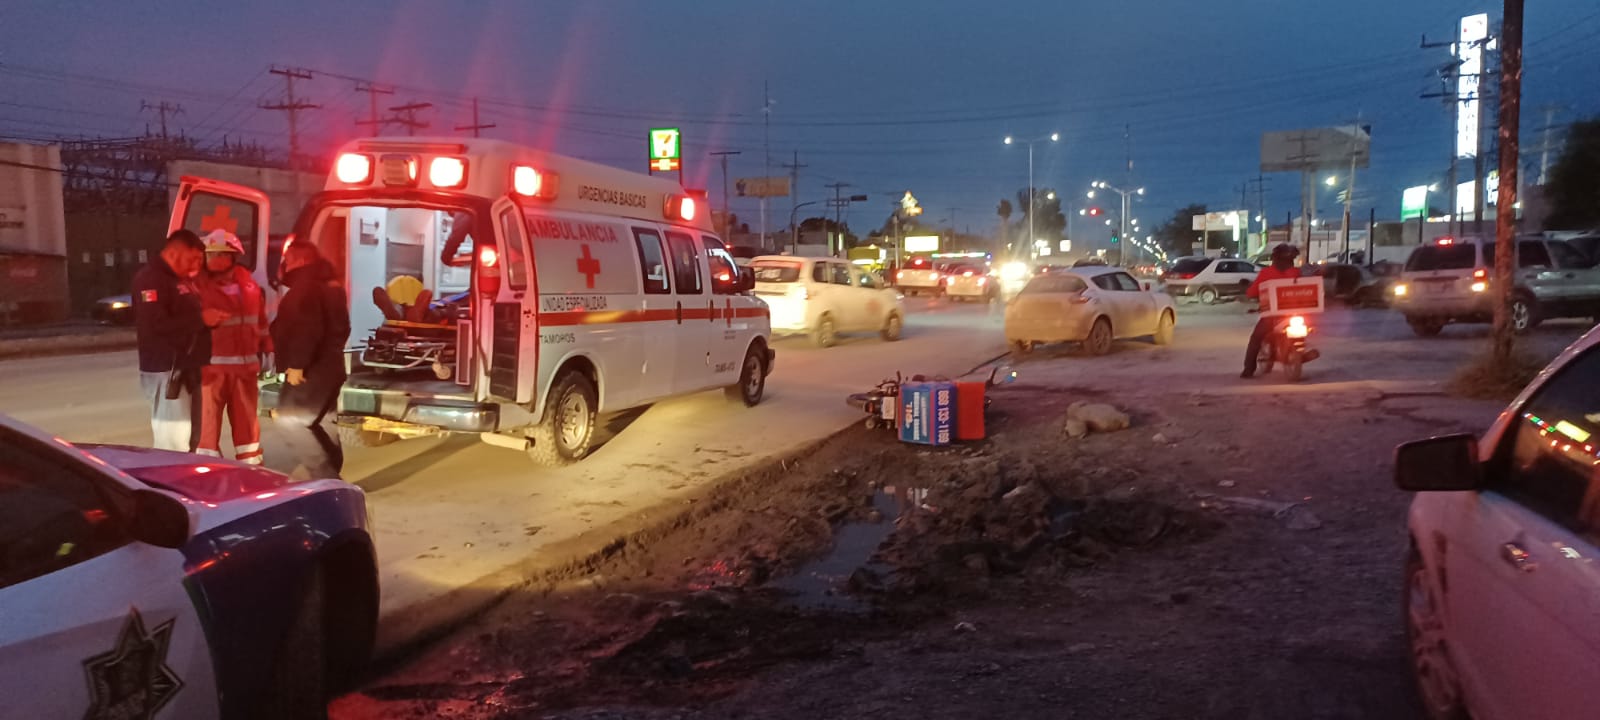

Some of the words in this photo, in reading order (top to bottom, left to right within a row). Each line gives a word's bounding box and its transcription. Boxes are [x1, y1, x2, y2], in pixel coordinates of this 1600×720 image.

[578, 184, 618, 205] URGENCIAS
[619, 191, 646, 208] BASICAS
[527, 219, 618, 243] AMBULANCIA
